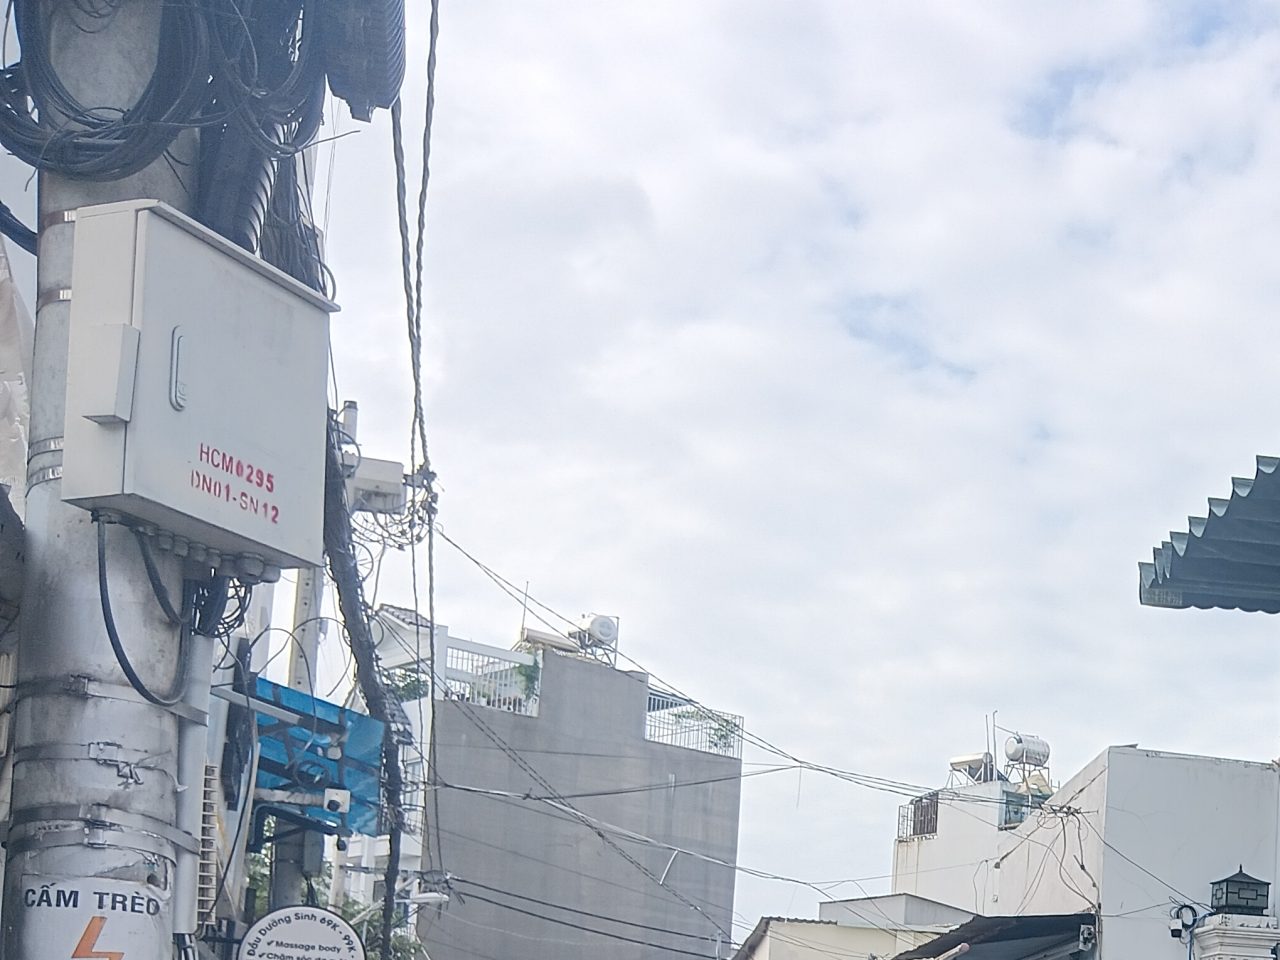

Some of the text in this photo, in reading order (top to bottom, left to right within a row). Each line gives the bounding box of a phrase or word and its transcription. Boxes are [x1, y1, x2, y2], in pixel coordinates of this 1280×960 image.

[200, 442, 274, 493] HCM0295
[24, 882, 160, 916] CẤM TRÈO
[275, 941, 341, 953] Massage body
[294, 912, 317, 921] Sinh
[320, 917, 340, 931] 69K
[342, 934, 357, 953] 99K
